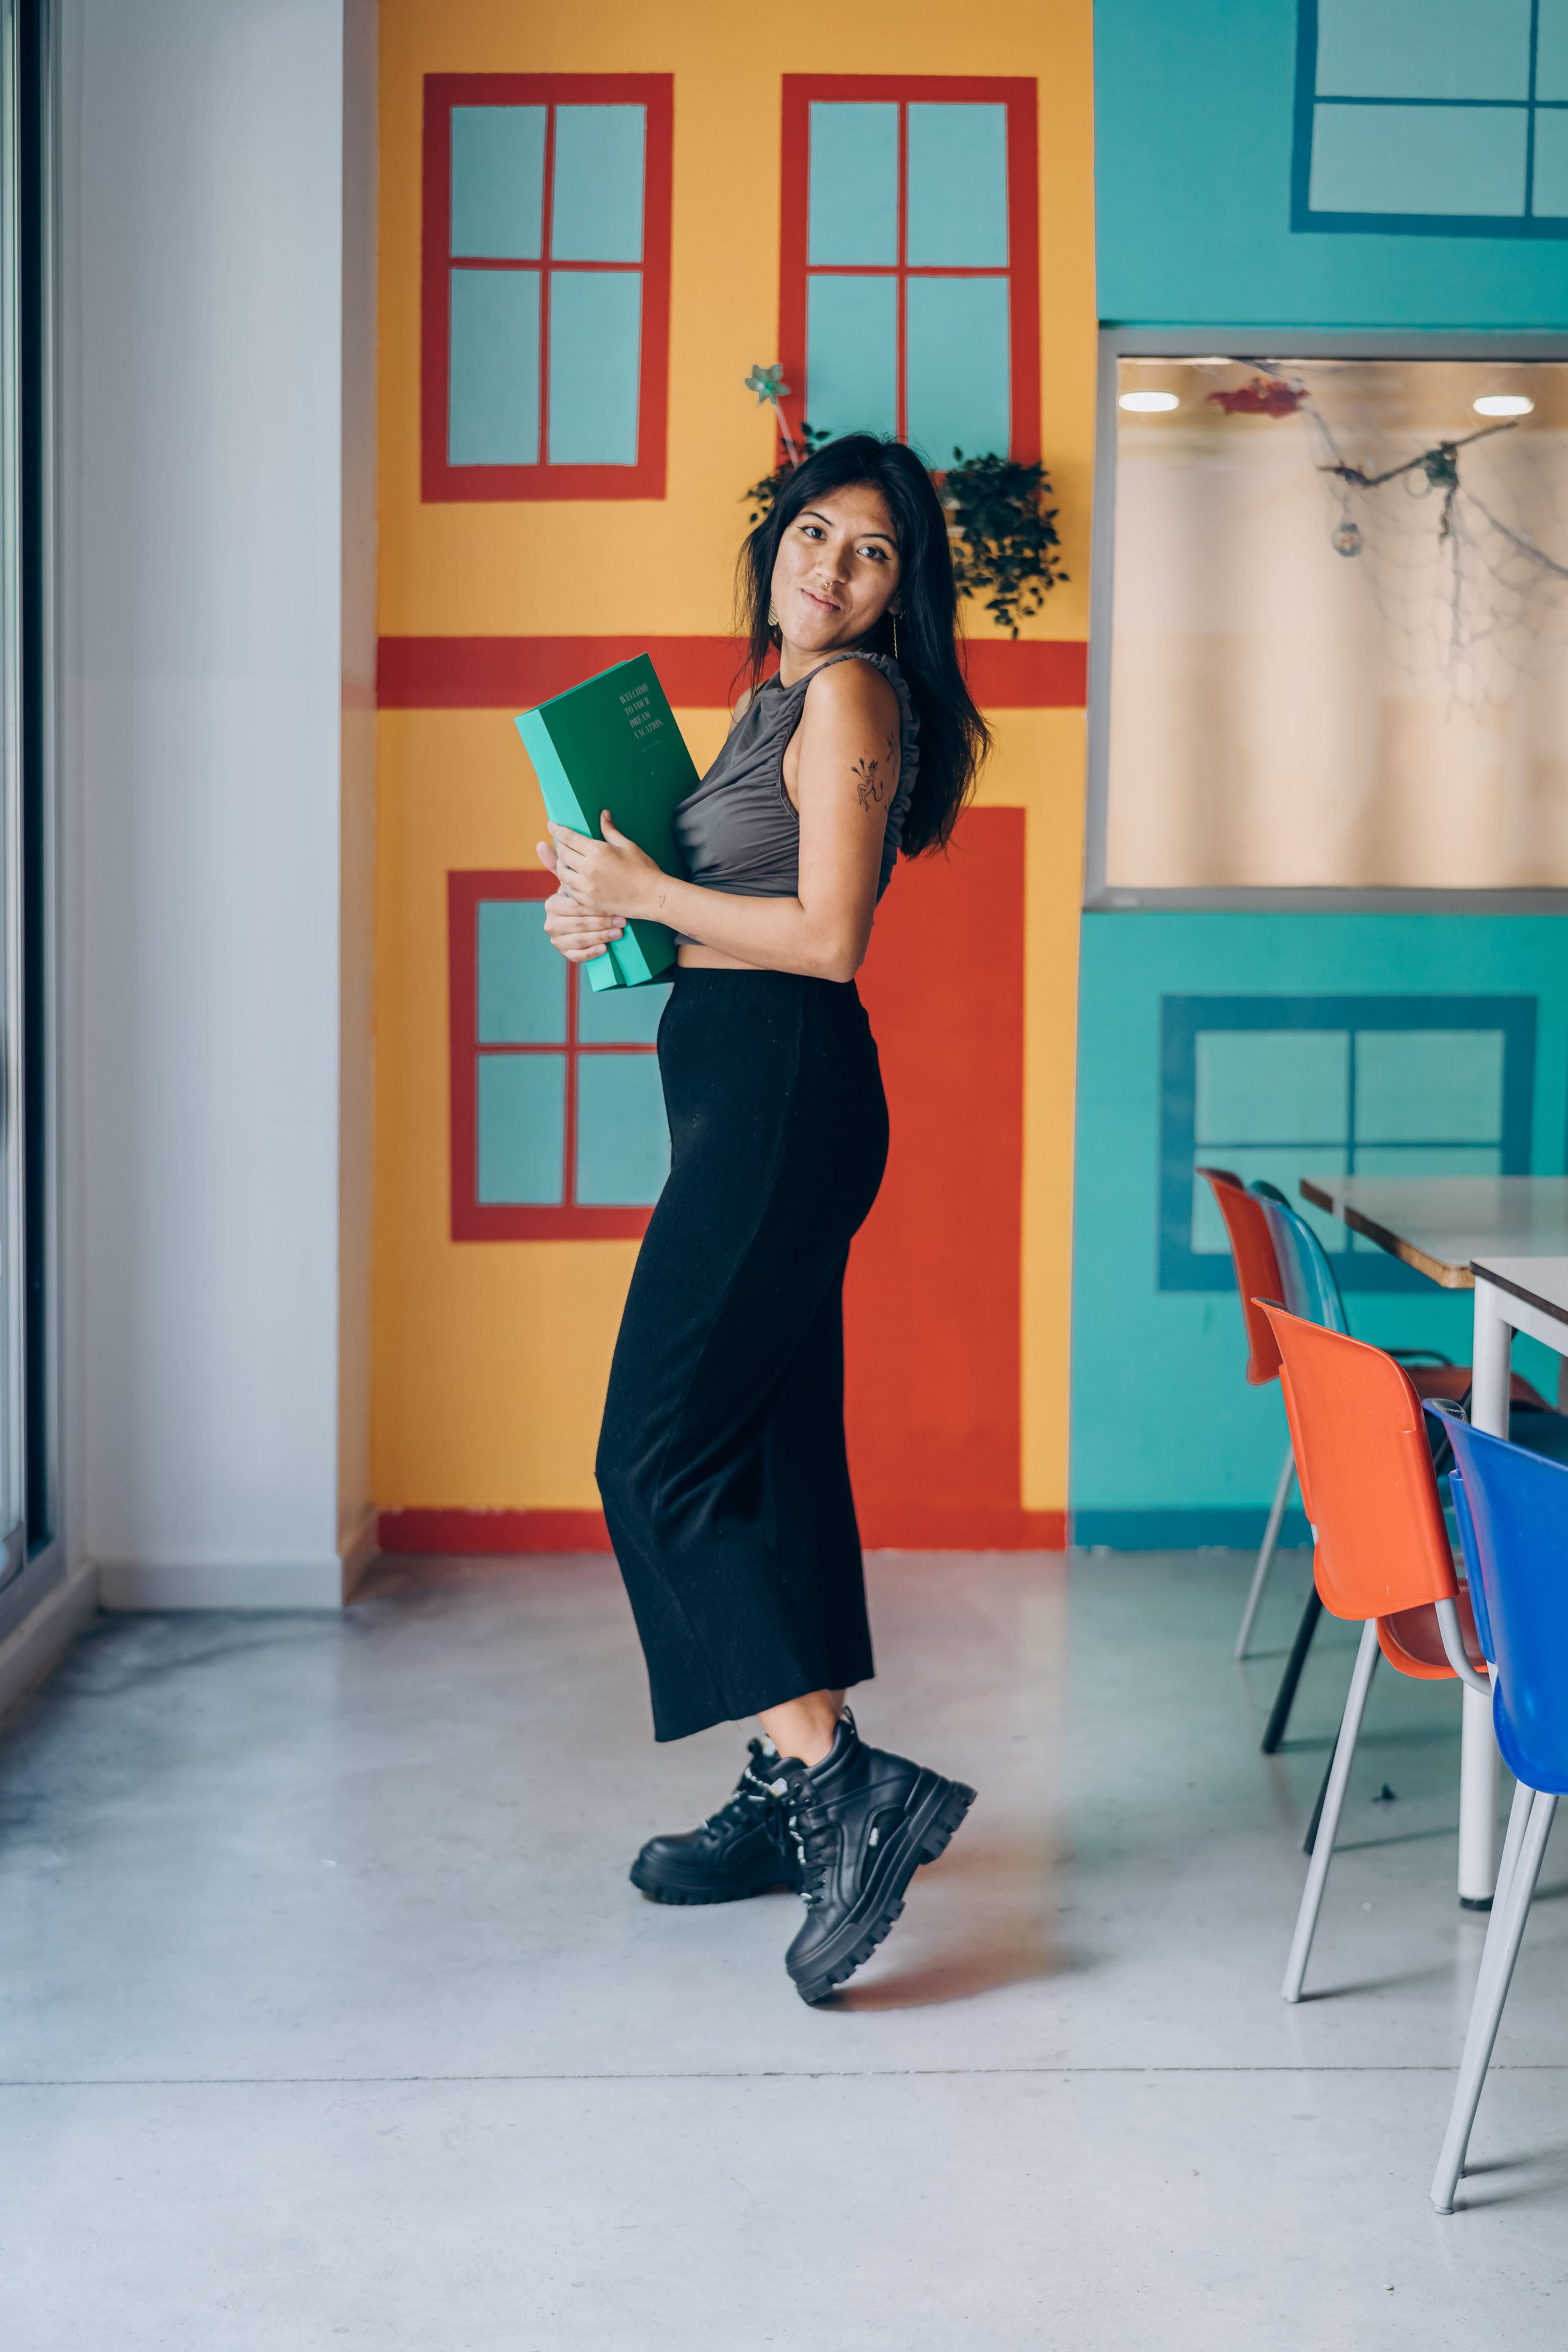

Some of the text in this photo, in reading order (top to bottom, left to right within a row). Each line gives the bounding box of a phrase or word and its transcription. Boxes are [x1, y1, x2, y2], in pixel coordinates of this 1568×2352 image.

[619, 683, 649, 704] WELCOME
[624, 697, 650, 716] TO YOUR
[629, 710, 651, 728] DREAM
